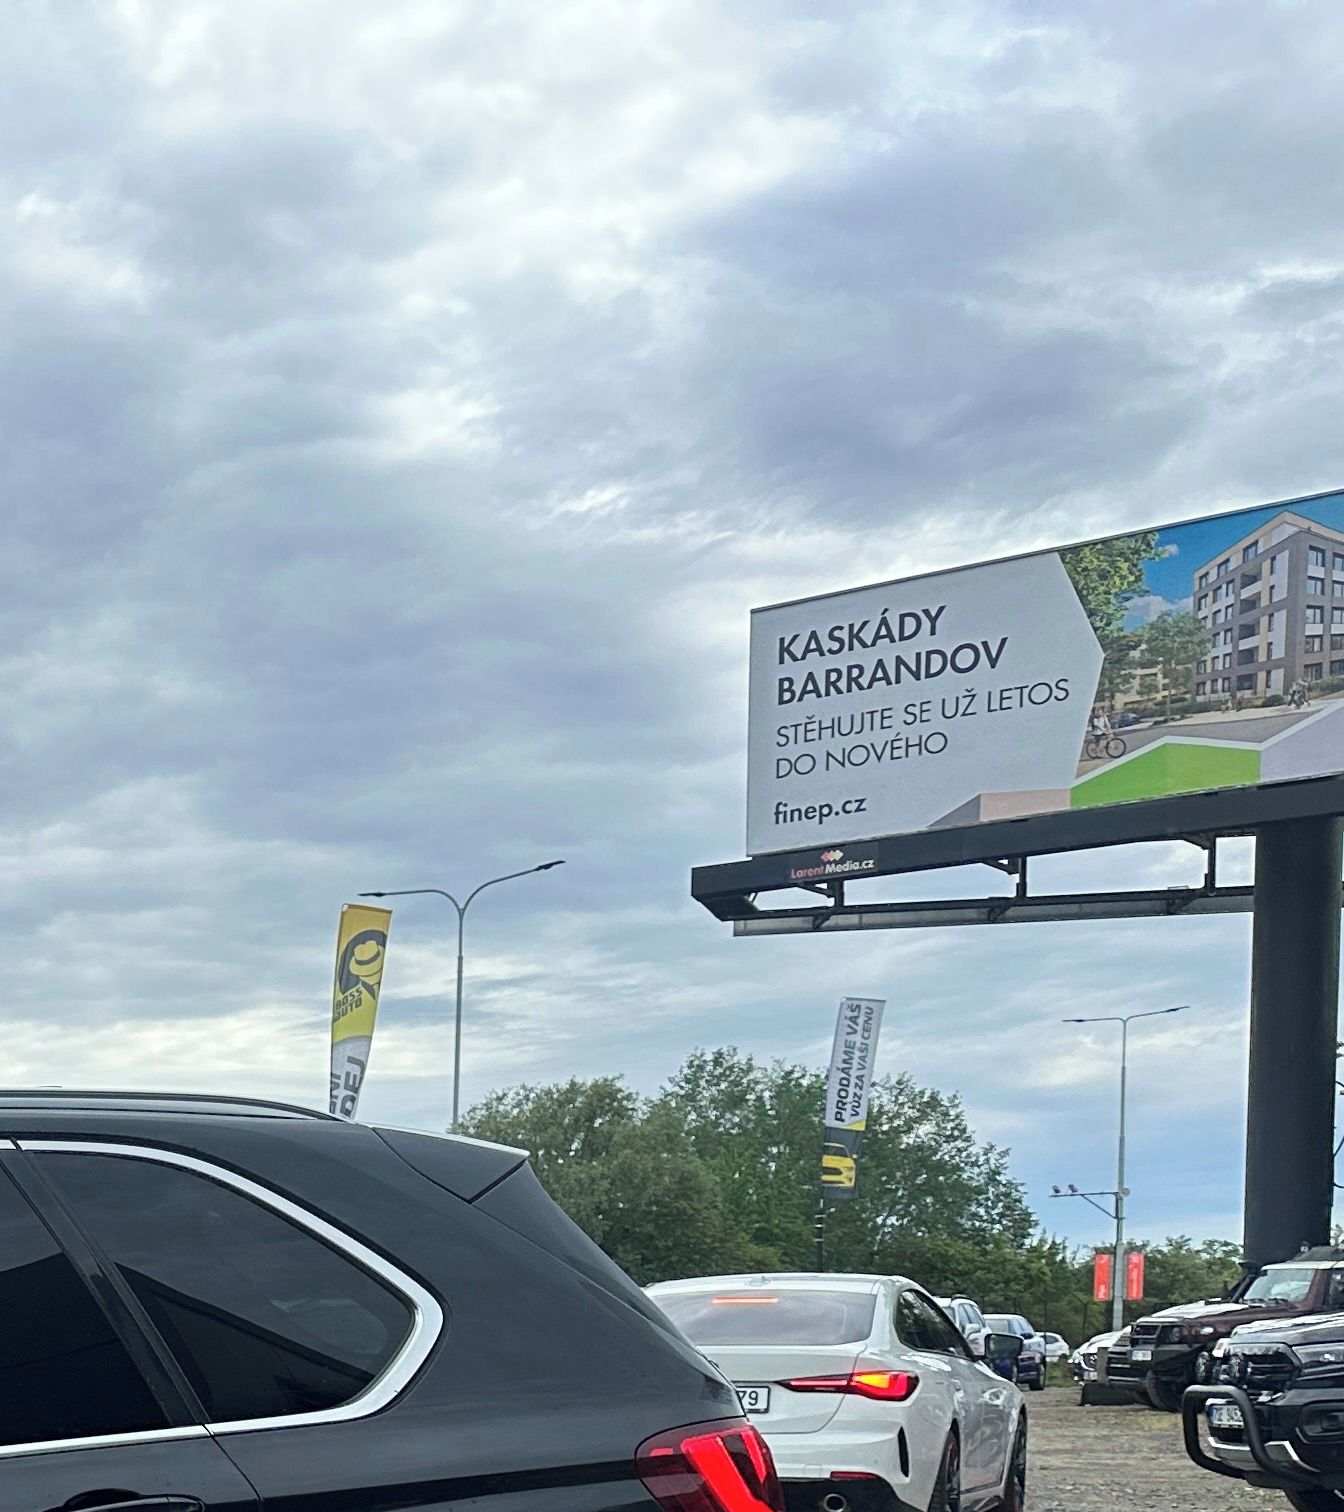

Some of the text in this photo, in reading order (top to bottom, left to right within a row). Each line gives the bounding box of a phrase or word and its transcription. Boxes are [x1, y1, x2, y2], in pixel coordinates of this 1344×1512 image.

[777, 604, 947, 665] KASKÁDY
[777, 636, 1009, 706] BARRANDOV
[775, 678, 1070, 748] STĚHUJTE SE UŽ LETOS
[775, 731, 948, 779] DO NOVÉHO
[774, 797, 867, 825] finep.cz
[834, 1003, 862, 1123] PRODÁME VÁŠ
[854, 1074, 865, 1091] ZA
[861, 1006, 874, 1041] CENU
